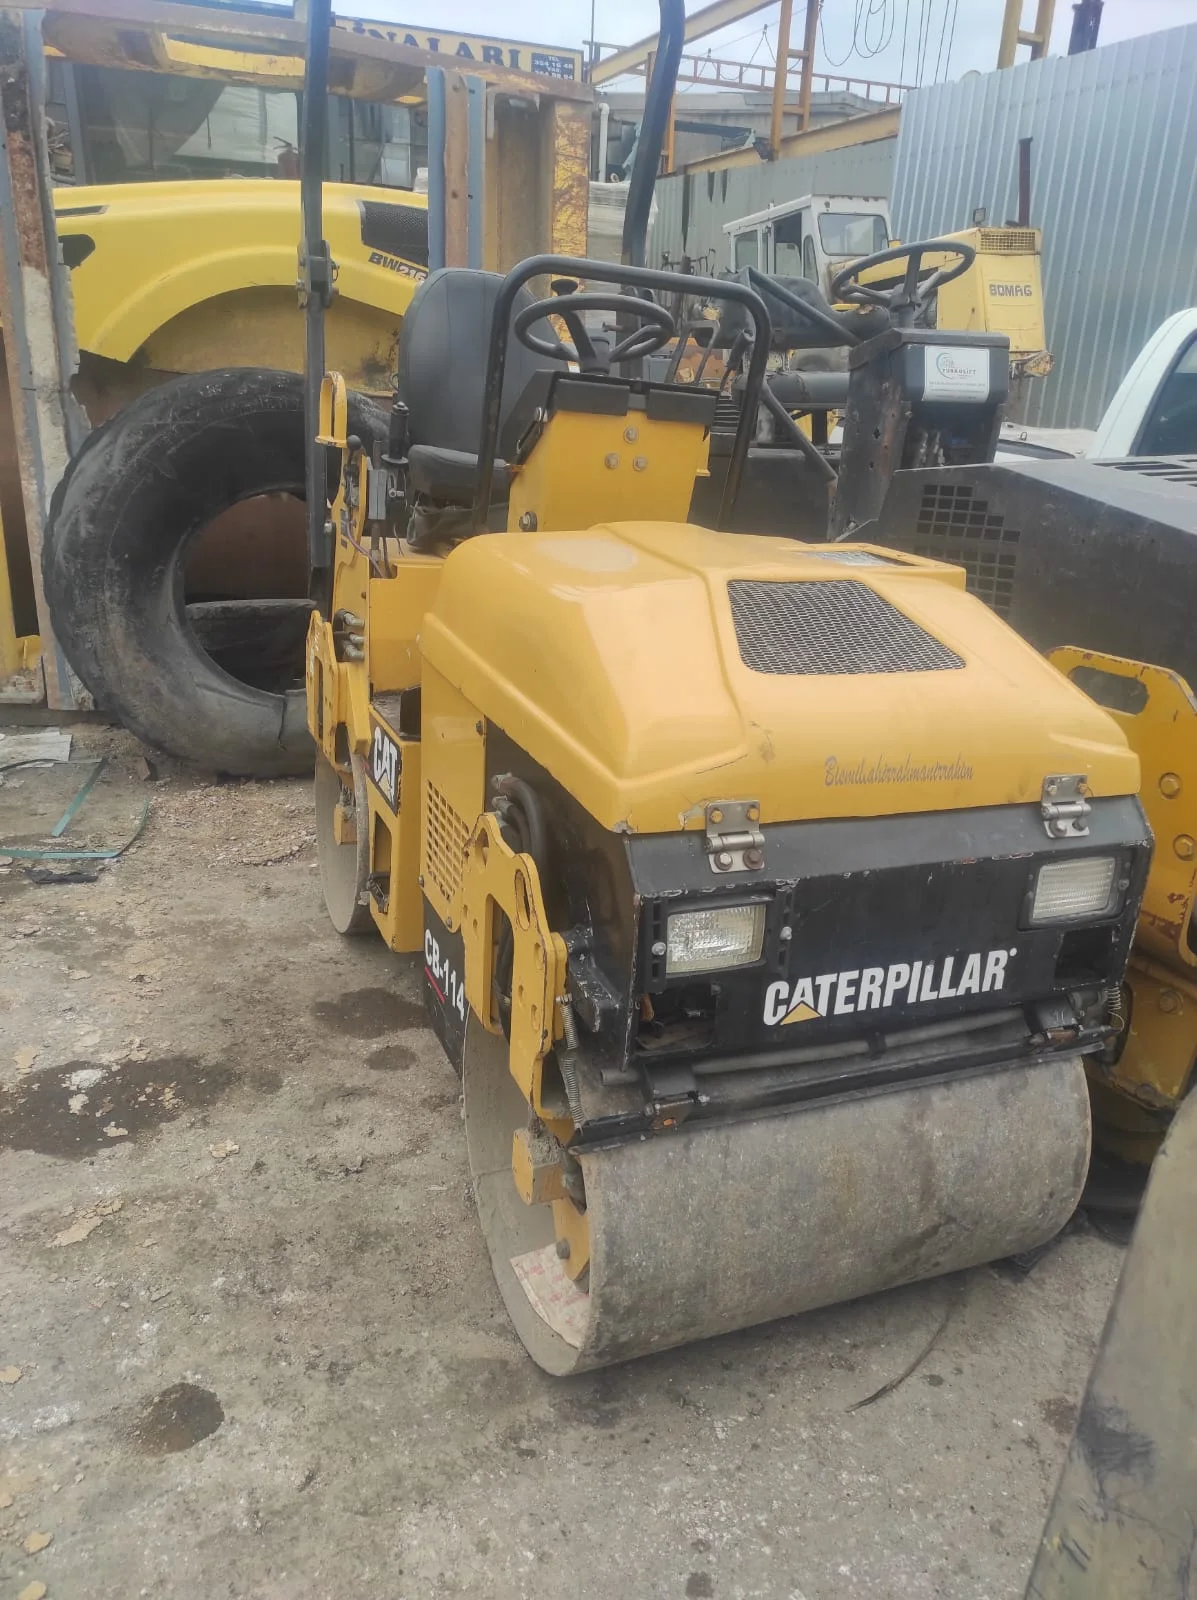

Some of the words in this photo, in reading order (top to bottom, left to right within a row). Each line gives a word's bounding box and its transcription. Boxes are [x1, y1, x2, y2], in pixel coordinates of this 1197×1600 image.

[989, 284, 1032, 297] BOMAG
[374, 726, 398, 806] CAT
[425, 929, 465, 1022] CB-114
[763, 949, 1009, 1026] CATERPILLAR
